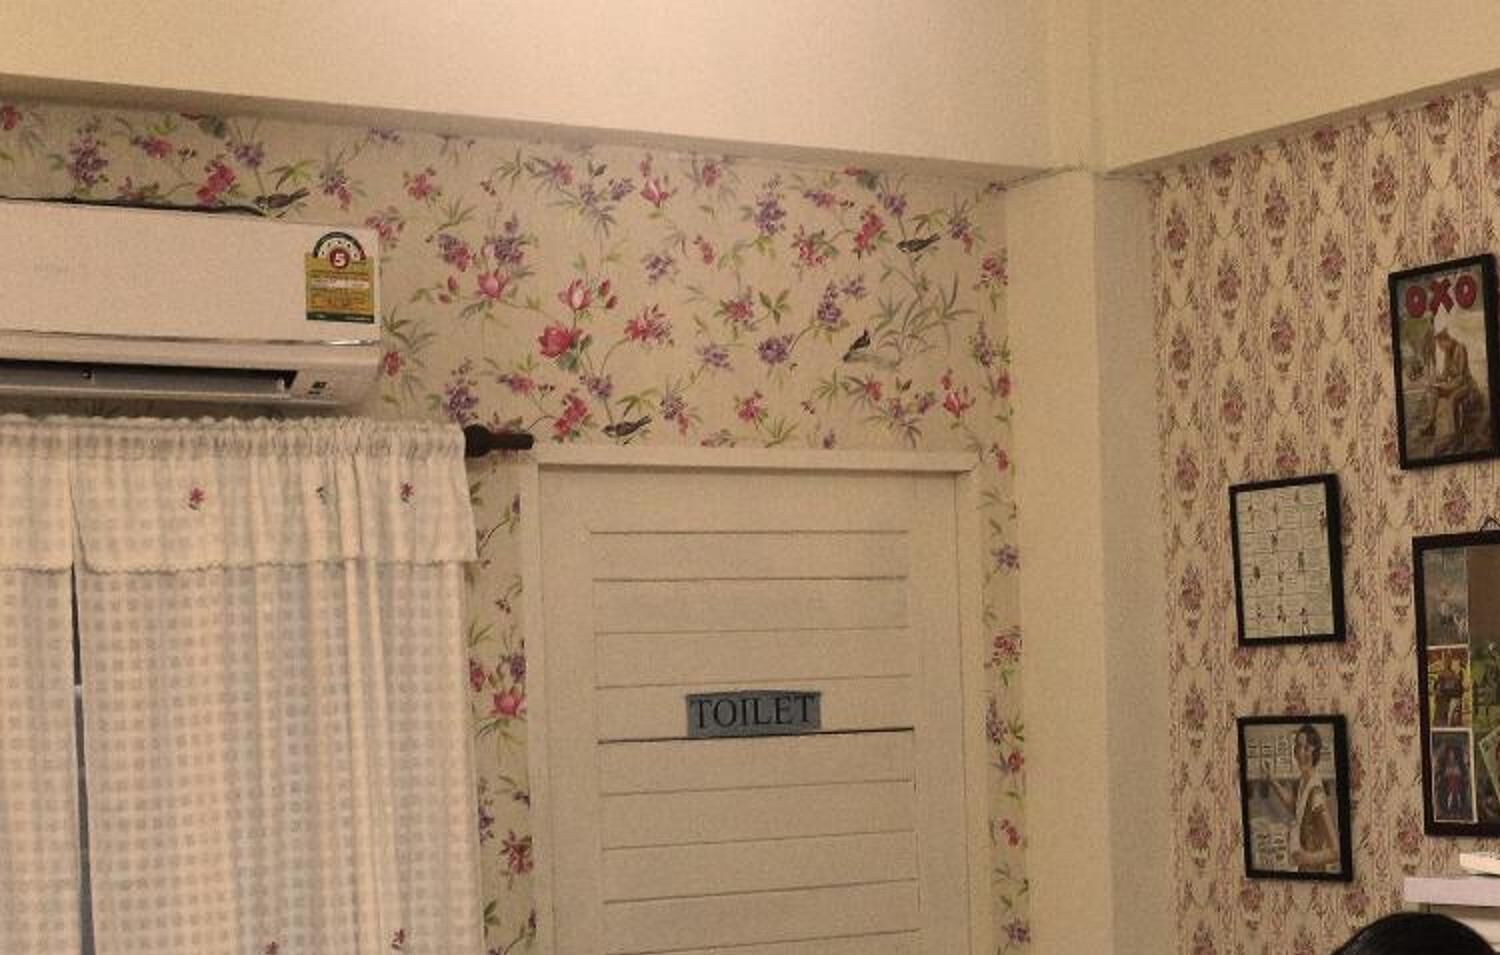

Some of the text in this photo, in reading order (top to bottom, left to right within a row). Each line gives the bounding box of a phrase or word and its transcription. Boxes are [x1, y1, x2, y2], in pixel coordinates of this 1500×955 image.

[335, 252, 347, 267] 5
[1406, 274, 1478, 318] OXO
[689, 695, 817, 729] TOILET
